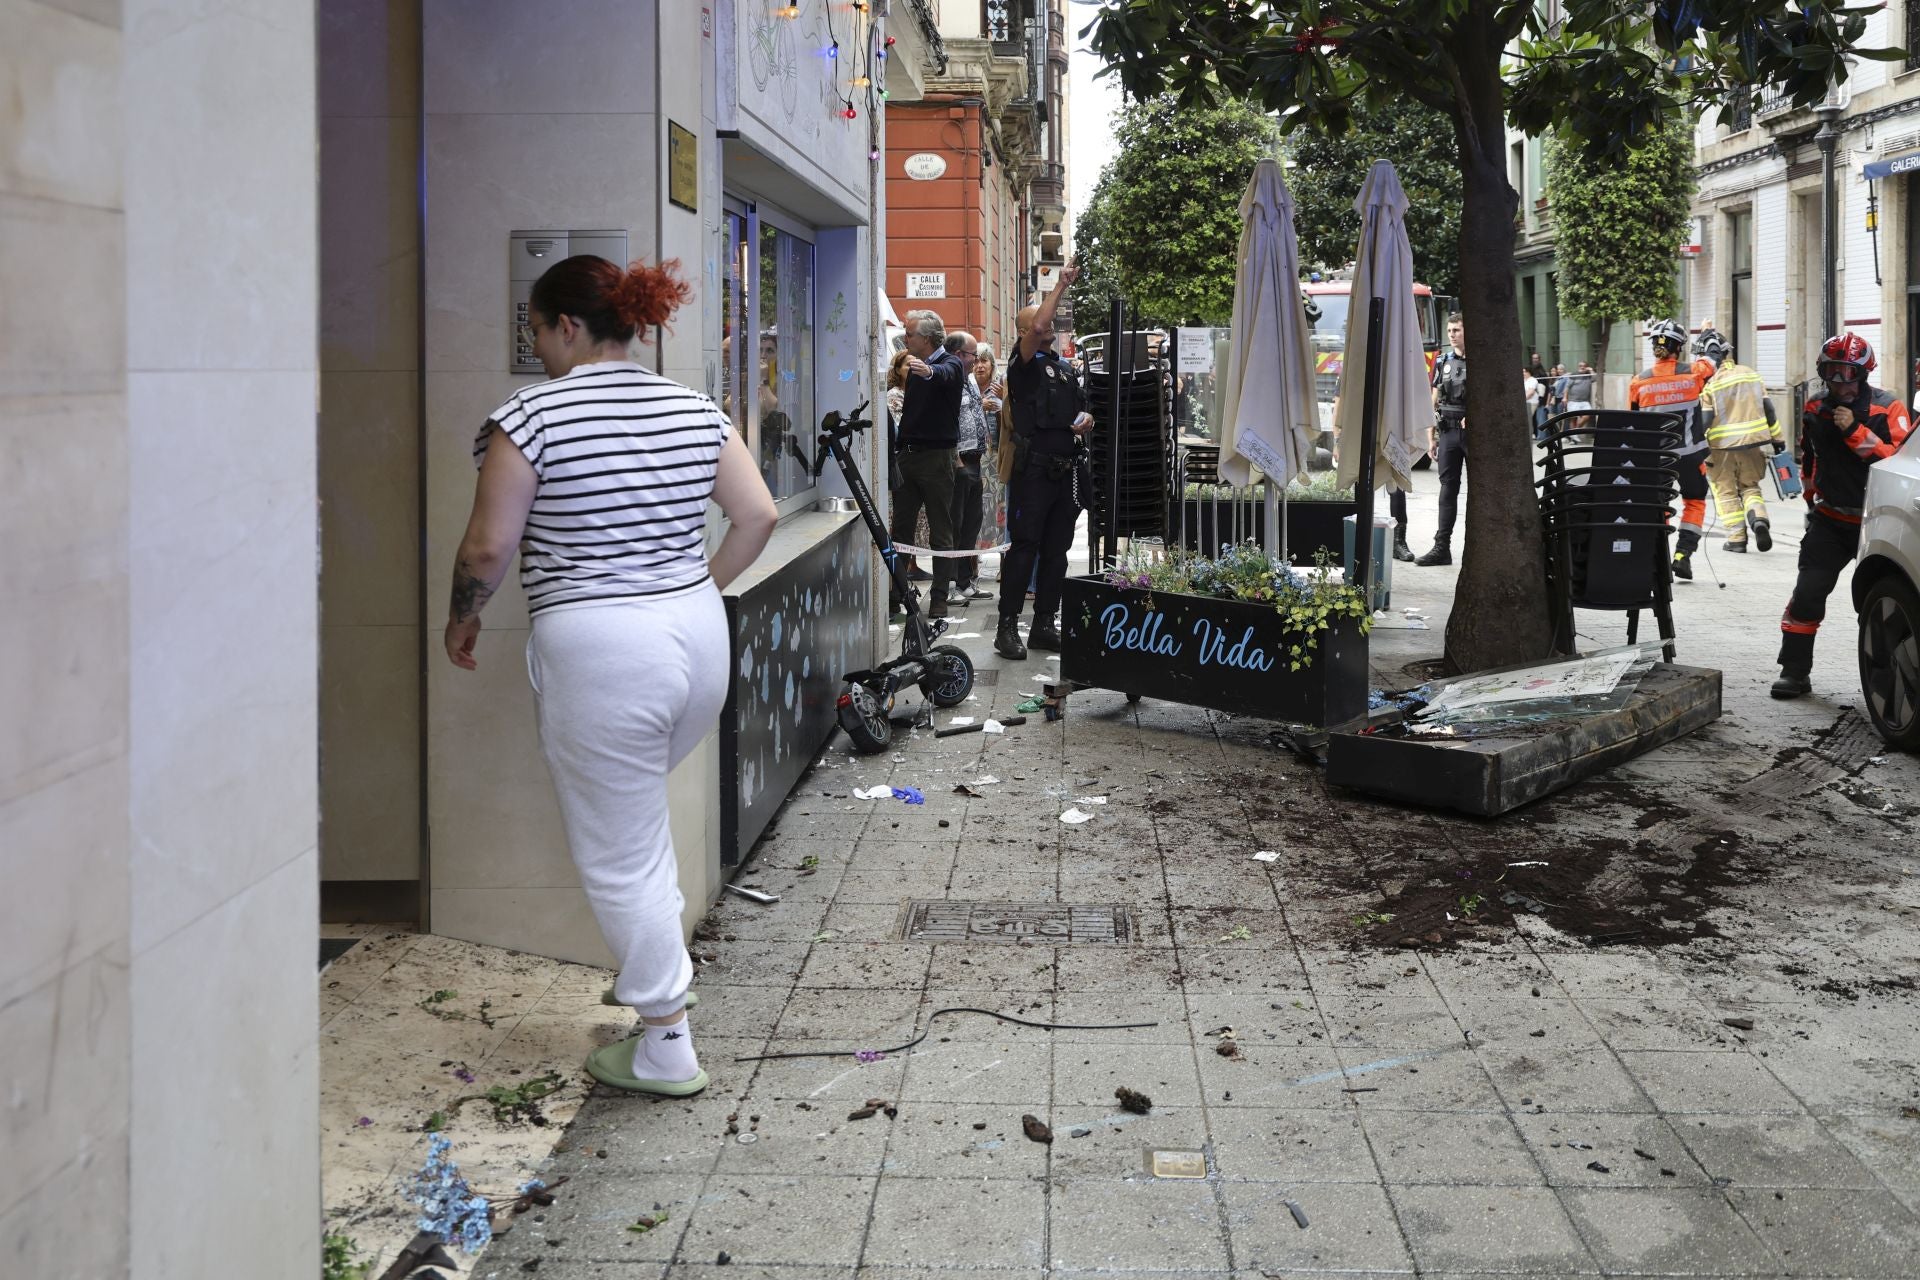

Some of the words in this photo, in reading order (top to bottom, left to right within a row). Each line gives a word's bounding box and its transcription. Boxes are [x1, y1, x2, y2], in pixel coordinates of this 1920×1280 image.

[920, 275, 940, 283] CALLE
[915, 289, 938, 297] VELASCO
[1639, 380, 1695, 394] BOMBEROS
[1100, 603, 1182, 657] Bella
[1193, 618, 1274, 672] Vida
